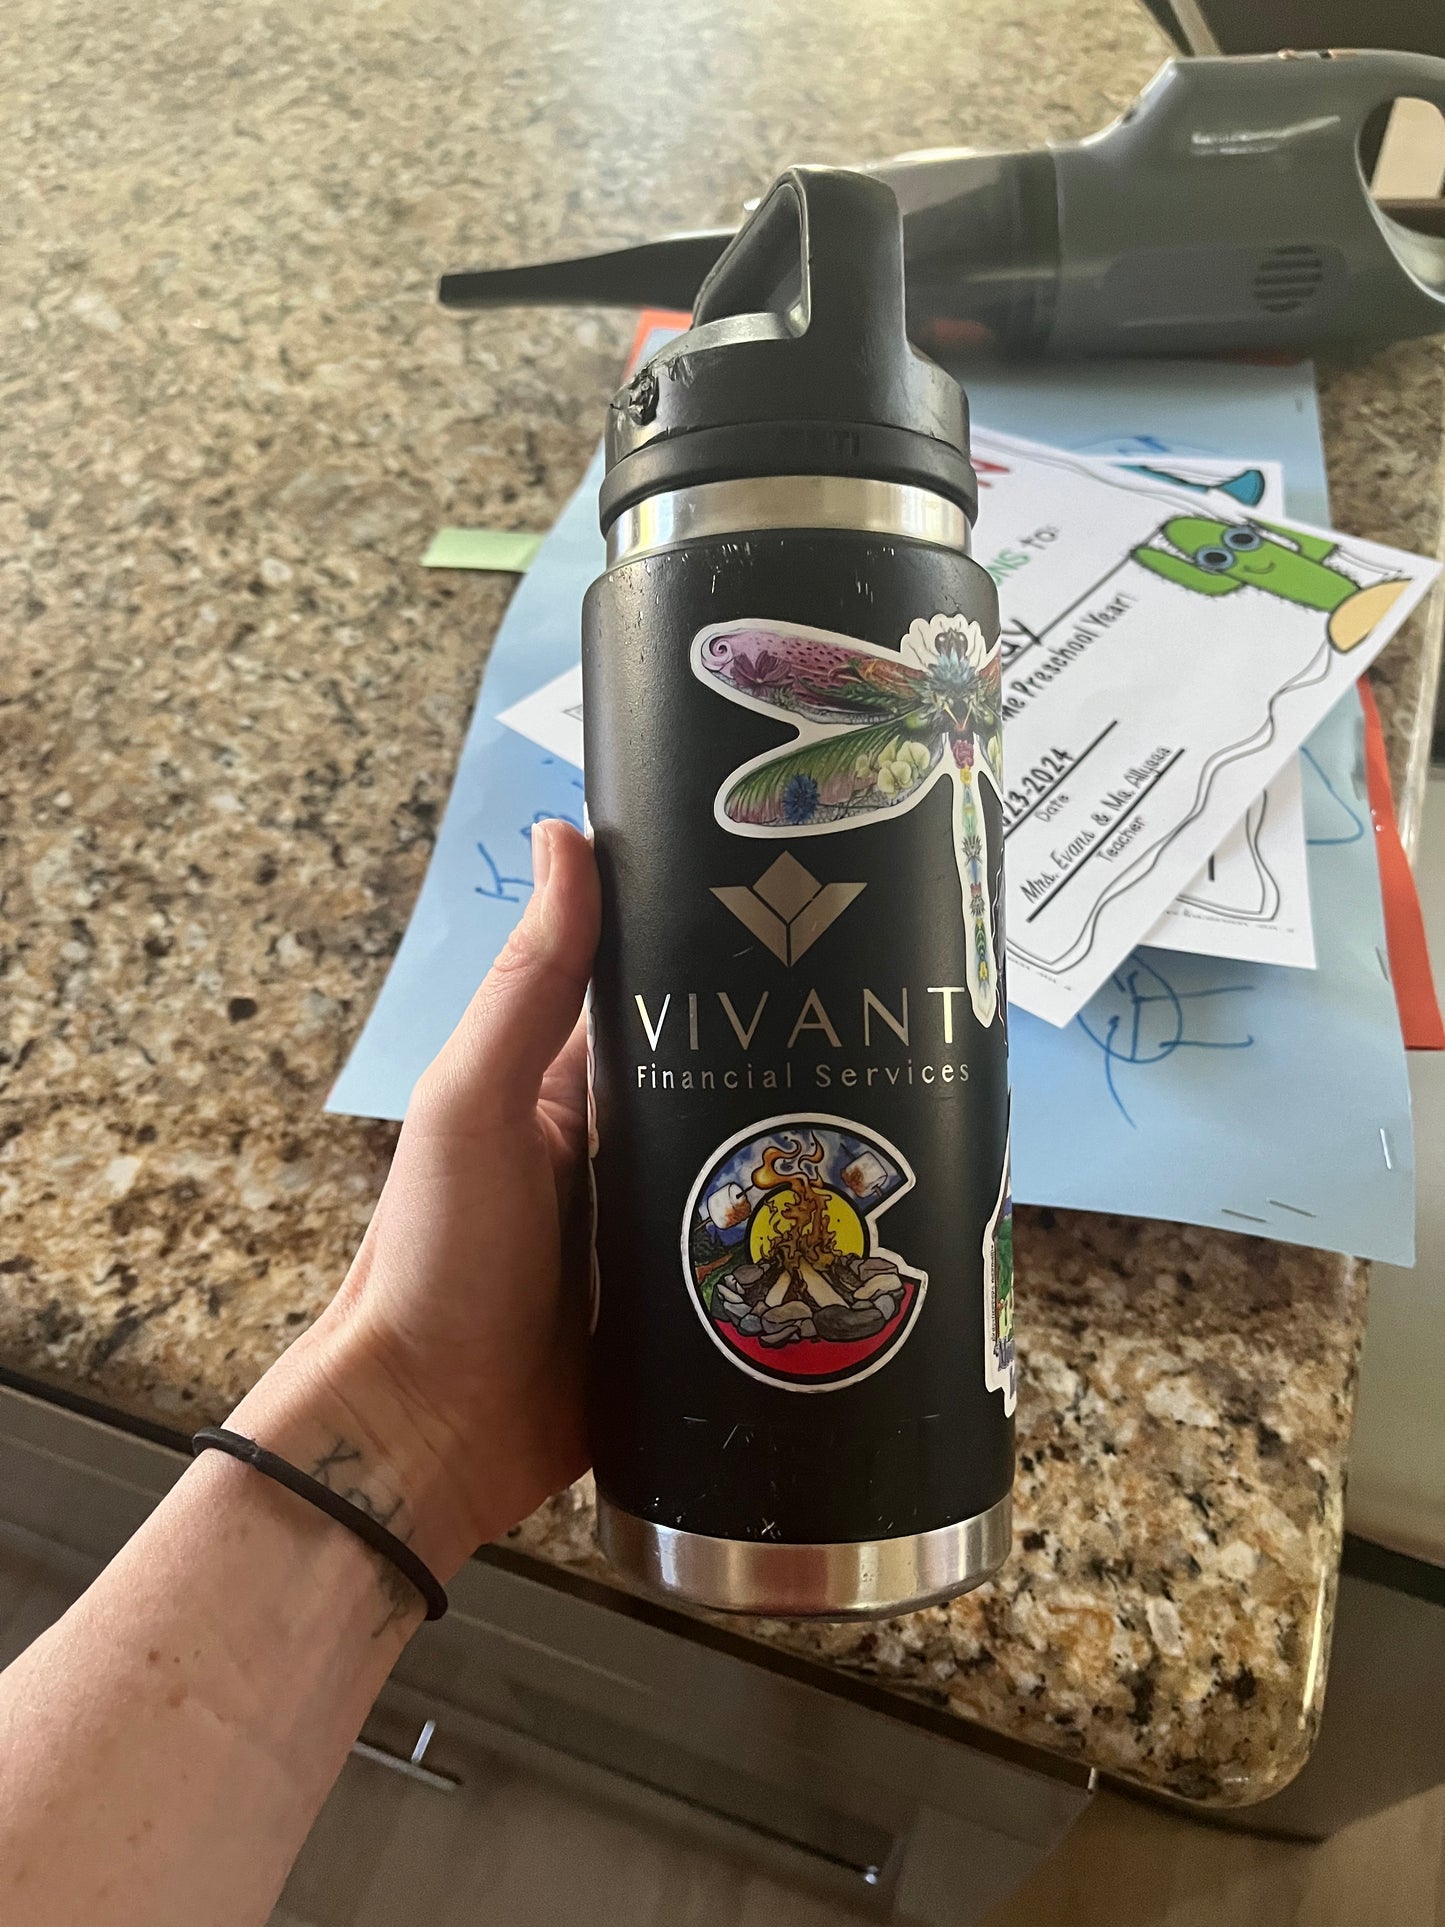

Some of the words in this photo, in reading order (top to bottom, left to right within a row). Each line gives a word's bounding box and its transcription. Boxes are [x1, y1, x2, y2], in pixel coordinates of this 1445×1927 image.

[1010, 624, 1101, 698] Preschool
[1034, 794, 1070, 823] Date
[1050, 830, 1096, 871] Evans
[1096, 816, 1145, 863] Teacher
[634, 986, 966, 1052] VIVANT
[637, 1061, 793, 1090] Financial
[815, 1058, 970, 1088] Services
